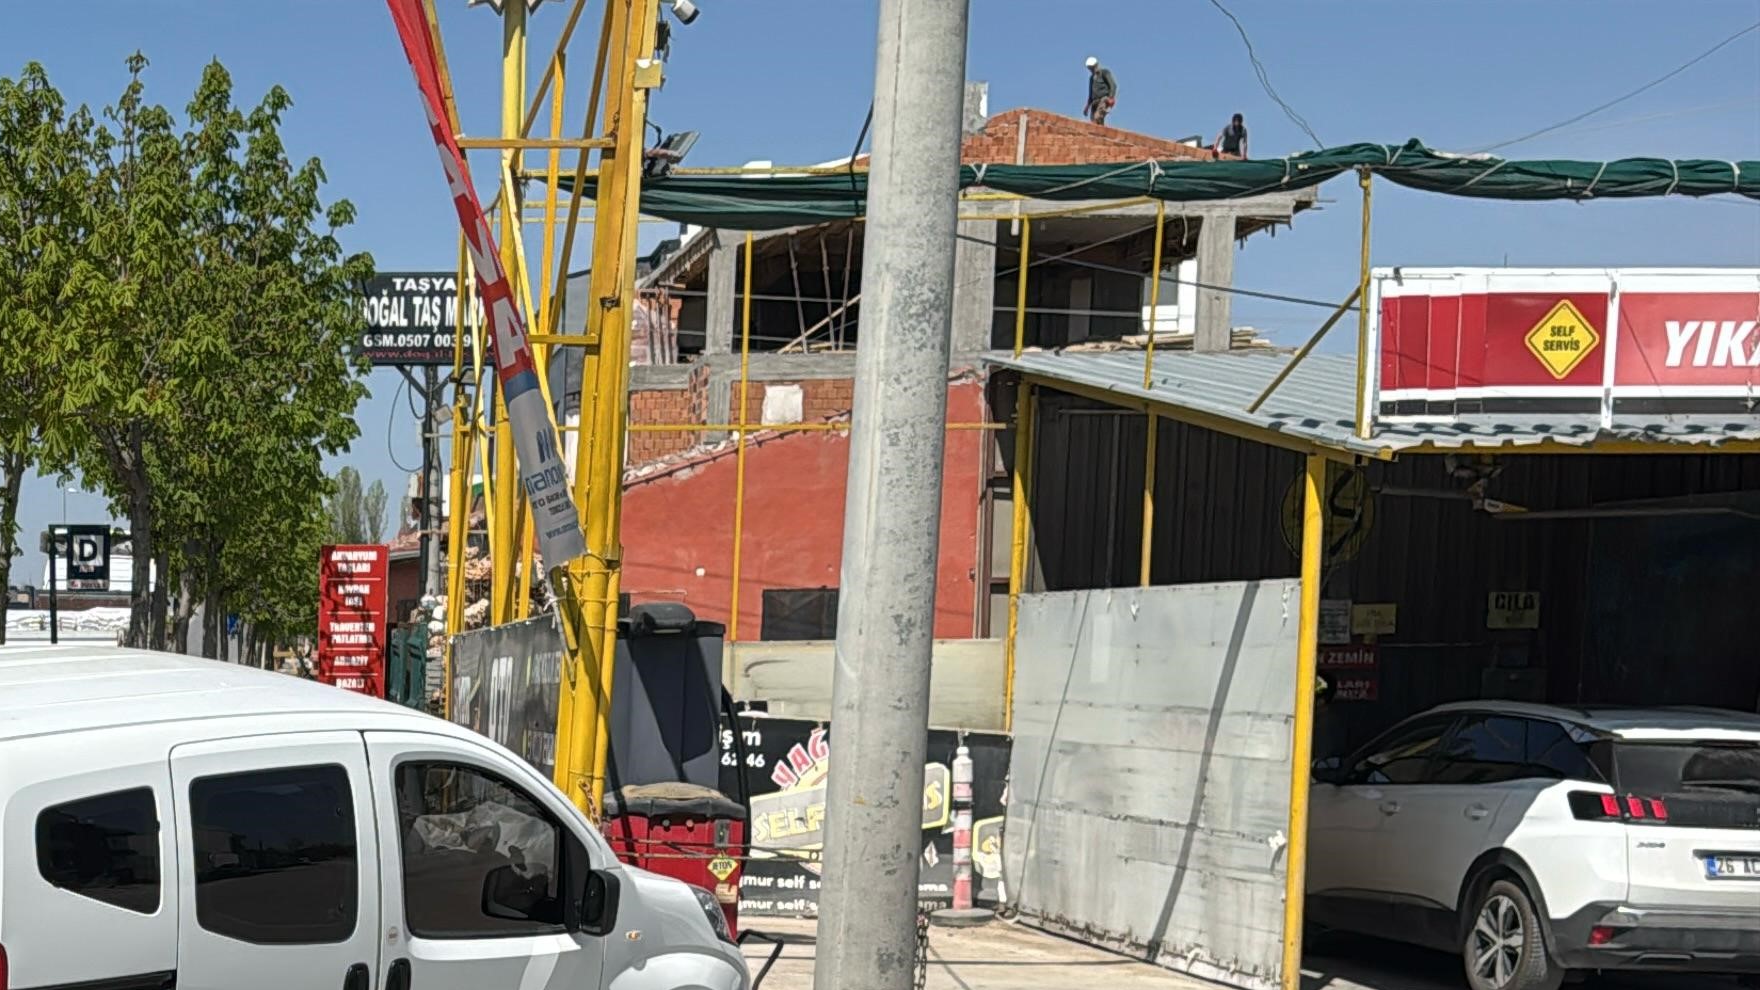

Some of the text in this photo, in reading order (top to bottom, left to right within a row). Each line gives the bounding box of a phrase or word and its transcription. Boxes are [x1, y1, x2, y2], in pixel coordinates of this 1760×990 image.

[413, 295, 441, 332] TAŞ
[1550, 325, 1575, 337] SELF
[1543, 339, 1580, 351] SERVİS
[78, 539, 97, 561] D
[1327, 648, 1375, 664] ZEMİN
[746, 753, 765, 767] 46
[1717, 857, 1735, 873] 26
[777, 874, 806, 889] self
[777, 898, 806, 911] self
